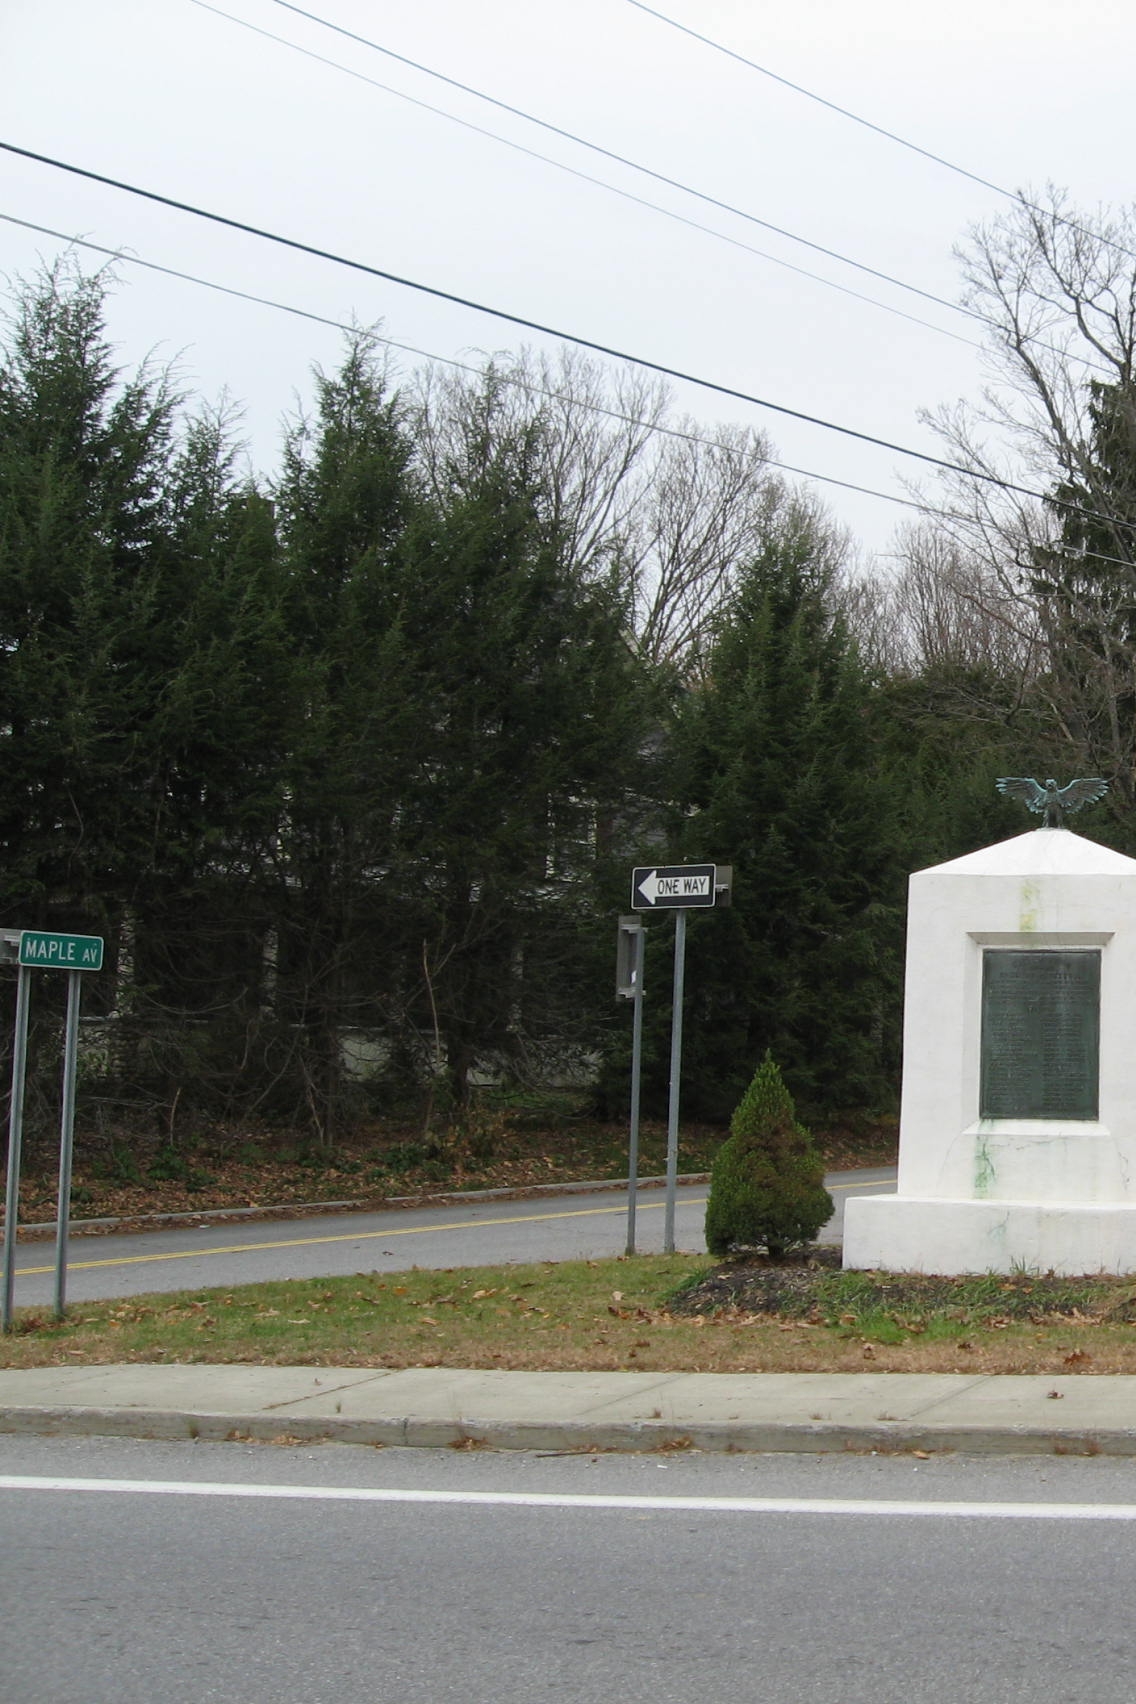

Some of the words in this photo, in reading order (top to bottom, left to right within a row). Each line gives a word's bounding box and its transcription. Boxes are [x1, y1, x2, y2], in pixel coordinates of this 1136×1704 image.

[657, 879, 680, 895] ONE
[683, 877, 707, 894] WAY
[25, 939, 76, 961] MAPLE
[82, 948, 98, 963] AV
